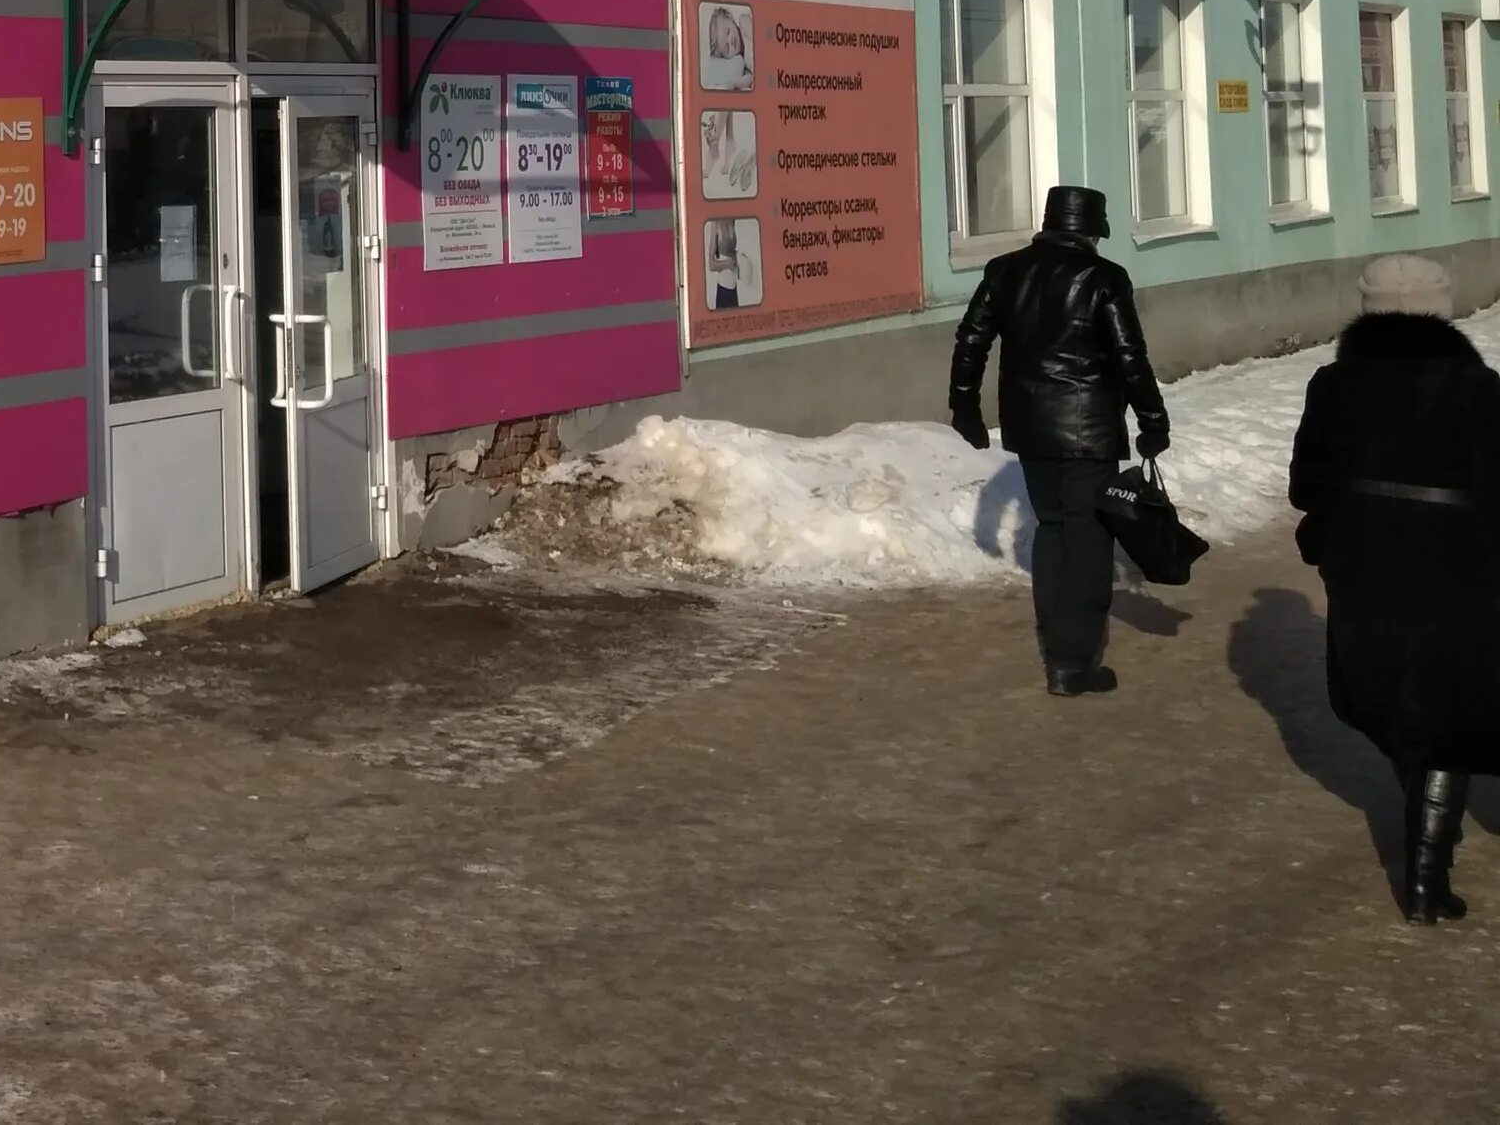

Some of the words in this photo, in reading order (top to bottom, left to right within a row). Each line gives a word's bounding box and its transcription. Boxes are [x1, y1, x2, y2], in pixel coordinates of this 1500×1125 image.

[776, 23, 857, 48] Ортопедические
[859, 34, 899, 53] подушки
[778, 69, 862, 94] Компрессионный
[450, 84, 491, 100] Клюква
[779, 105, 826, 125] трикотаж
[596, 125, 622, 135] РАБОТЫ
[612, 154, 623, 171] 18
[778, 149, 858, 173] Ортопедические
[861, 152, 896, 166] стельки
[444, 181, 455, 190] БЕЗ
[458, 179, 481, 191] ОБЕДА
[613, 186, 624, 202] 15
[435, 196, 447, 206] БЕЗ
[449, 195, 490, 206] ВЫХОДНЫХ
[520, 193, 539, 208] 9.00
[550, 192, 573, 207] 17.00
[781, 199, 842, 222] Корректоры
[844, 198, 878, 214] осанки,
[783, 230, 830, 249] бандажи,
[832, 226, 885, 250] фиксаторы
[785, 261, 828, 283] суставов
